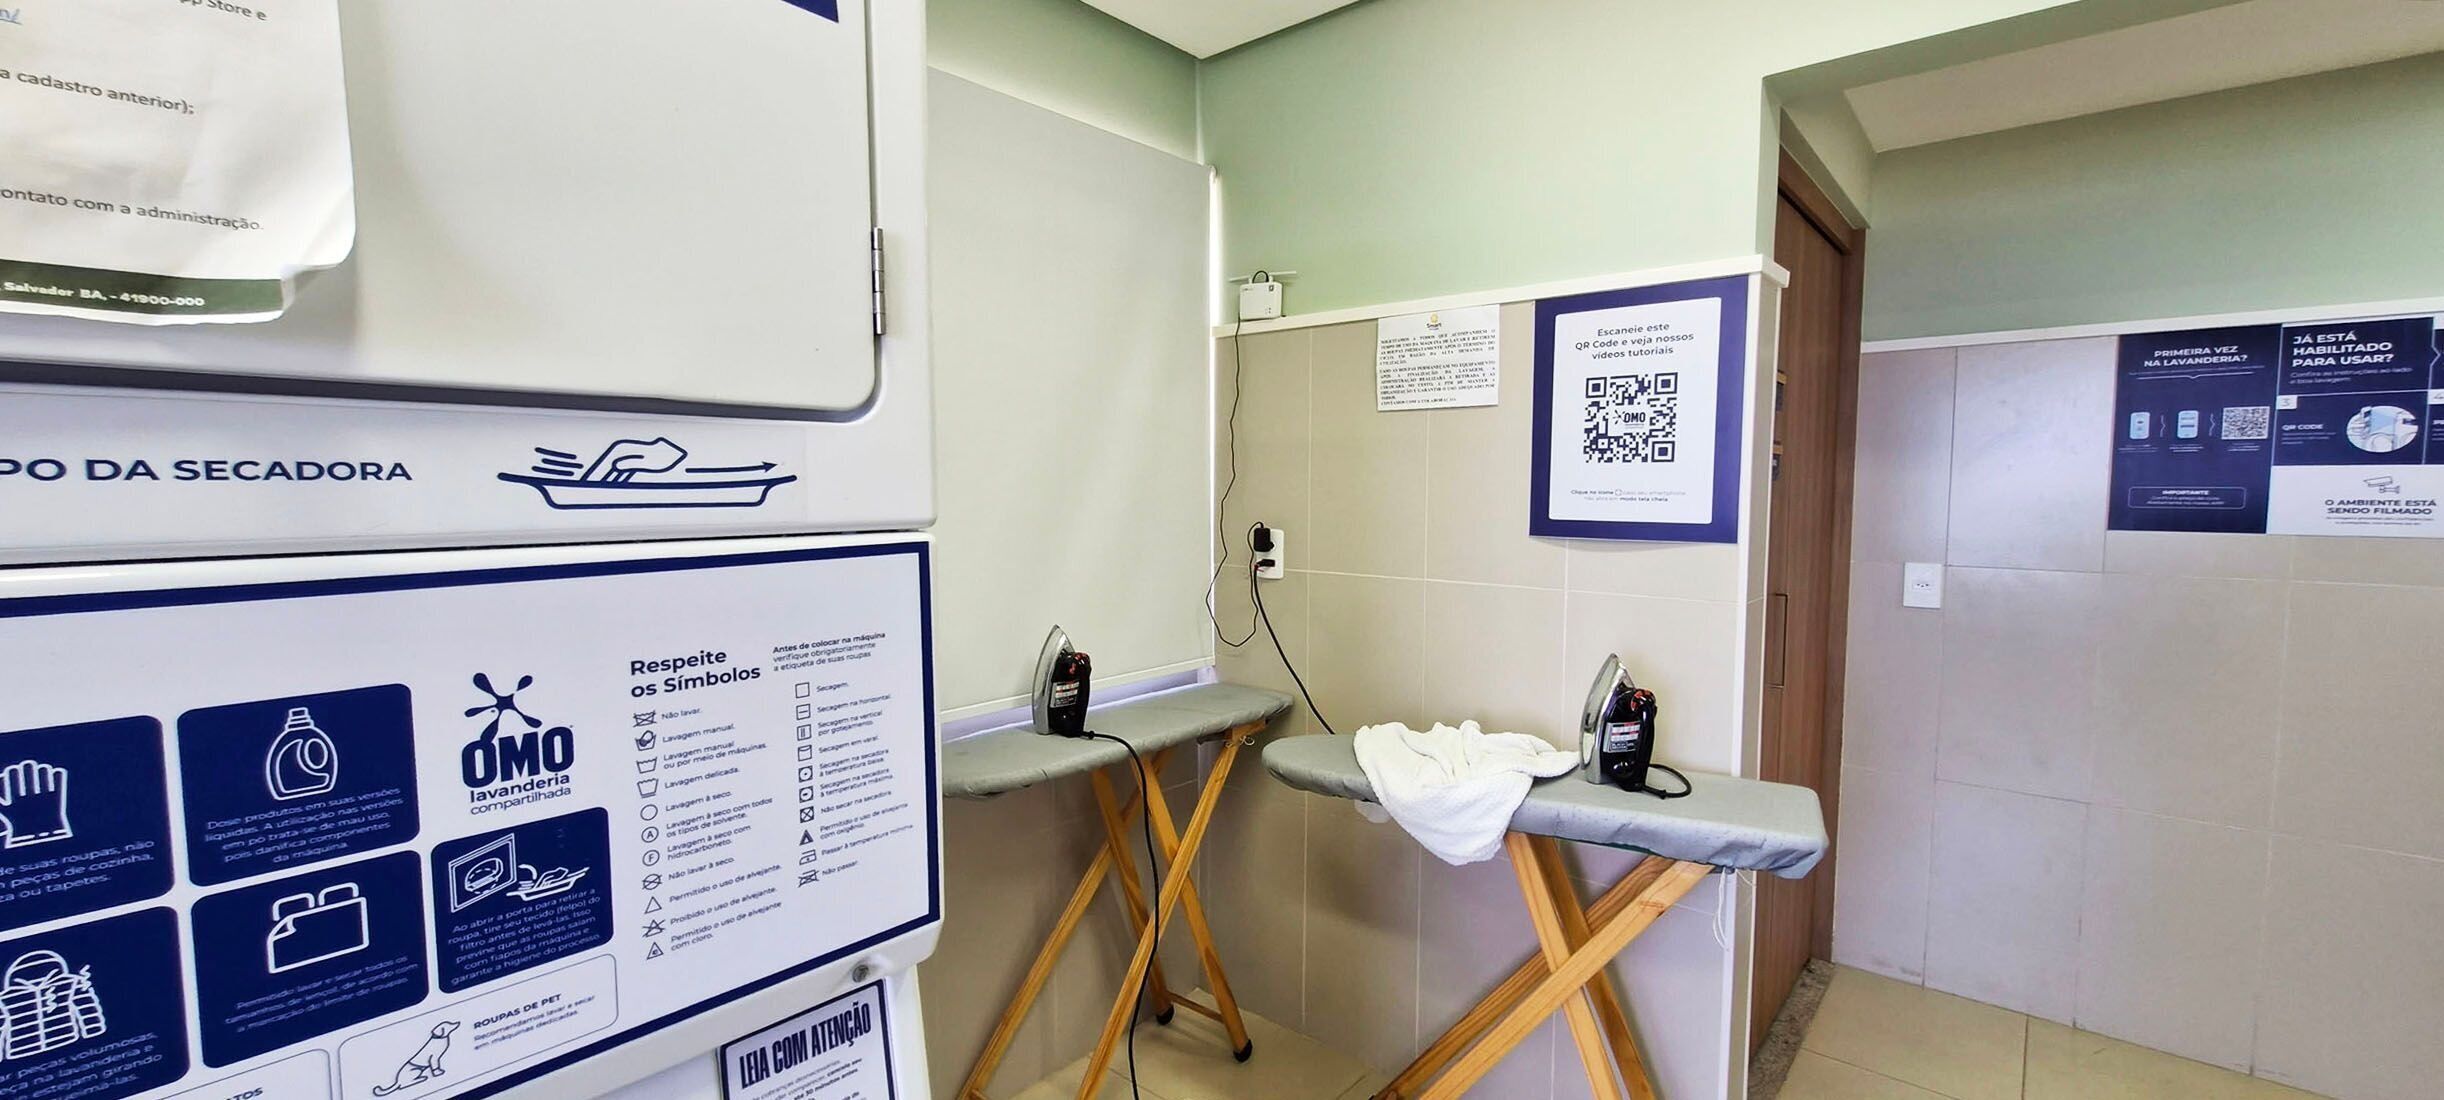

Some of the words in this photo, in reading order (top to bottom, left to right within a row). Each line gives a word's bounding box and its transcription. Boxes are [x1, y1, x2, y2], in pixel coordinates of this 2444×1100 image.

[207, 0, 251, 18] Store
[257, 11, 267, 21] e
[0, 70, 10, 79] a
[18, 71, 102, 97] cadastro
[108, 89, 194, 115] anterior);
[74, 199, 114, 213] com
[120, 204, 131, 215] a
[137, 205, 264, 230] administração.
[4, 282, 74, 296] Salvador
[120, 293, 205, 306] 41900-000
[1597, 325, 1643, 336] Escaneie
[1647, 323, 1670, 332] este
[2293, 333, 2313, 344] JÁ
[2317, 330, 2356, 343] ESTÁ
[1575, 342, 1590, 350] QR
[1592, 339, 1618, 348] Code
[1631, 337, 1653, 346] veja
[1656, 333, 1694, 343] nossos
[2293, 342, 2392, 356] HABILITADO
[1592, 349, 1625, 360] vídeos
[1628, 347, 1674, 357] tutoriais
[2144, 359, 2160, 367] NA
[2164, 355, 2248, 366] LAVANDERIA?
[2154, 347, 2210, 358] PRIMEIRA
[2292, 358, 2336, 367] PARA
[2340, 354, 2394, 365] USAR?
[1623, 412, 1646, 423] OMO
[86, 459, 159, 481] DA
[174, 459, 413, 482] SECADORA
[2405, 498, 2437, 506] ESTÁ
[773, 644, 797, 654] Antes
[812, 639, 840, 648] colocar
[853, 632, 885, 641] máquina
[773, 650, 809, 663] verifique
[811, 642, 876, 657] obrigatoriamente
[631, 650, 727, 676] Respeite
[781, 660, 814, 670] etiqueta
[816, 657, 826, 665] de
[846, 651, 871, 661] roupas
[631, 683, 657, 697] os
[664, 668, 760, 693] Símbolos
[662, 711, 679, 720] Não
[663, 730, 701, 743] Lavagem
[462, 726, 574, 788] OMO
[664, 749, 701, 761] Lavagem
[677, 758, 691, 768] por
[693, 753, 714, 762] meio
[716, 750, 726, 759] de
[471, 773, 569, 803] lavanderia
[665, 775, 703, 789] Lavagem
[305, 802, 326, 810] em
[338, 807, 359, 815] nas
[471, 786, 571, 815] compartilhada
[666, 798, 704, 812] Lavagem
[667, 816, 704, 830] Lavagem
[713, 808, 731, 817] seco
[733, 804, 750, 813] com
[752, 798, 772, 807] todos
[667, 839, 705, 852] Lavagem
[714, 831, 732, 840] seco
[734, 825, 751, 835] com
[678, 825, 699, 837] tipos
[700, 821, 711, 829] de
[19, 858, 58, 872] suas
[125, 840, 155, 851] não
[12, 870, 61, 888] peças
[65, 866, 86, 876] de
[89, 854, 154, 871] cozinha.
[668, 870, 686, 880] Não
[688, 865, 707, 875] lavar
[19, 887, 41, 898] ou
[46, 874, 111, 892] tapetes.
[669, 885, 711, 903] Permitido
[719, 879, 733, 888] uso
[735, 875, 745, 883] de
[453, 925, 467, 933] Ao
[470, 917, 494, 928] abrir
[506, 906, 532, 919] porta
[536, 900, 557, 910] para
[559, 891, 586, 902] retirar
[484, 925, 501, 934] tire
[504, 920, 521, 928] seu
[524, 910, 555, 922] tecido
[670, 909, 705, 925] Proibido
[714, 902, 728, 911] uso
[460, 940, 485, 951] filtro
[488, 931, 516, 943] antes
[518, 926, 531, 934] de
[671, 924, 712, 942] Permitido
[721, 917, 735, 926] uso
[671, 940, 690, 951] com
[474, 1008, 520, 1029] ROUPAS
[523, 1002, 538, 1012] DE
[542, 994, 561, 1006] PET
[740, 1047, 770, 1089] LEIA
[772, 1029, 808, 1074] COM
[812, 1001, 871, 1047] ATENÇÃO
